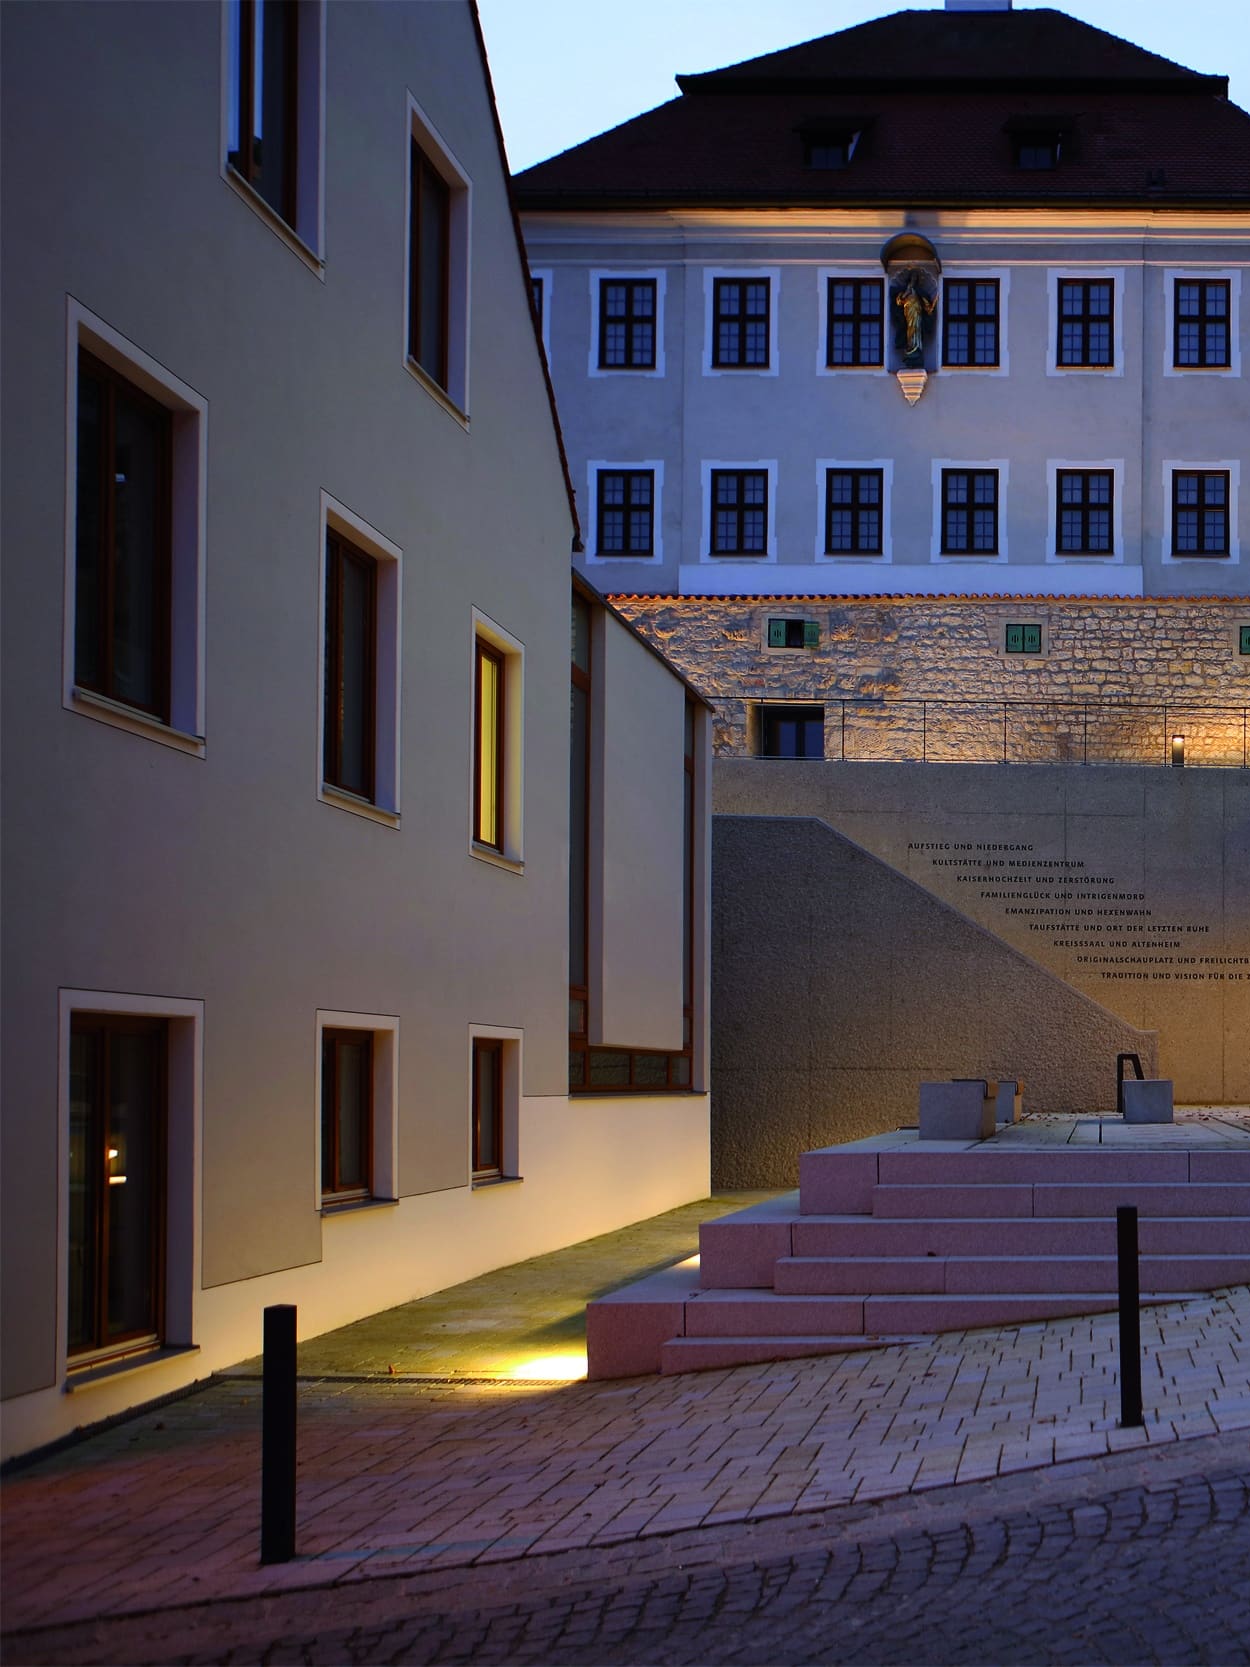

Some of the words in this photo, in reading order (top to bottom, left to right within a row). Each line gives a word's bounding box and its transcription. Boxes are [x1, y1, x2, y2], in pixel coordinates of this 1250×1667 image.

[933, 858, 982, 866] KULTSTÄTTE
[1009, 860, 1084, 868] MEDIENZENTRUM
[957, 875, 1032, 883] KAISERHOCHZEIT
[1058, 875, 1115, 884] ZERSTÖRUNG
[981, 891, 1051, 899] FAMILIENGLÜCK
[1077, 892, 1145, 901] INTRIGENMORD
[1029, 922, 1080, 931] TAUFSTÄTTE
[1077, 956, 1174, 964] ORIGINALSCHAUPLATZ
[1208, 971, 1225, 980] FÜR
